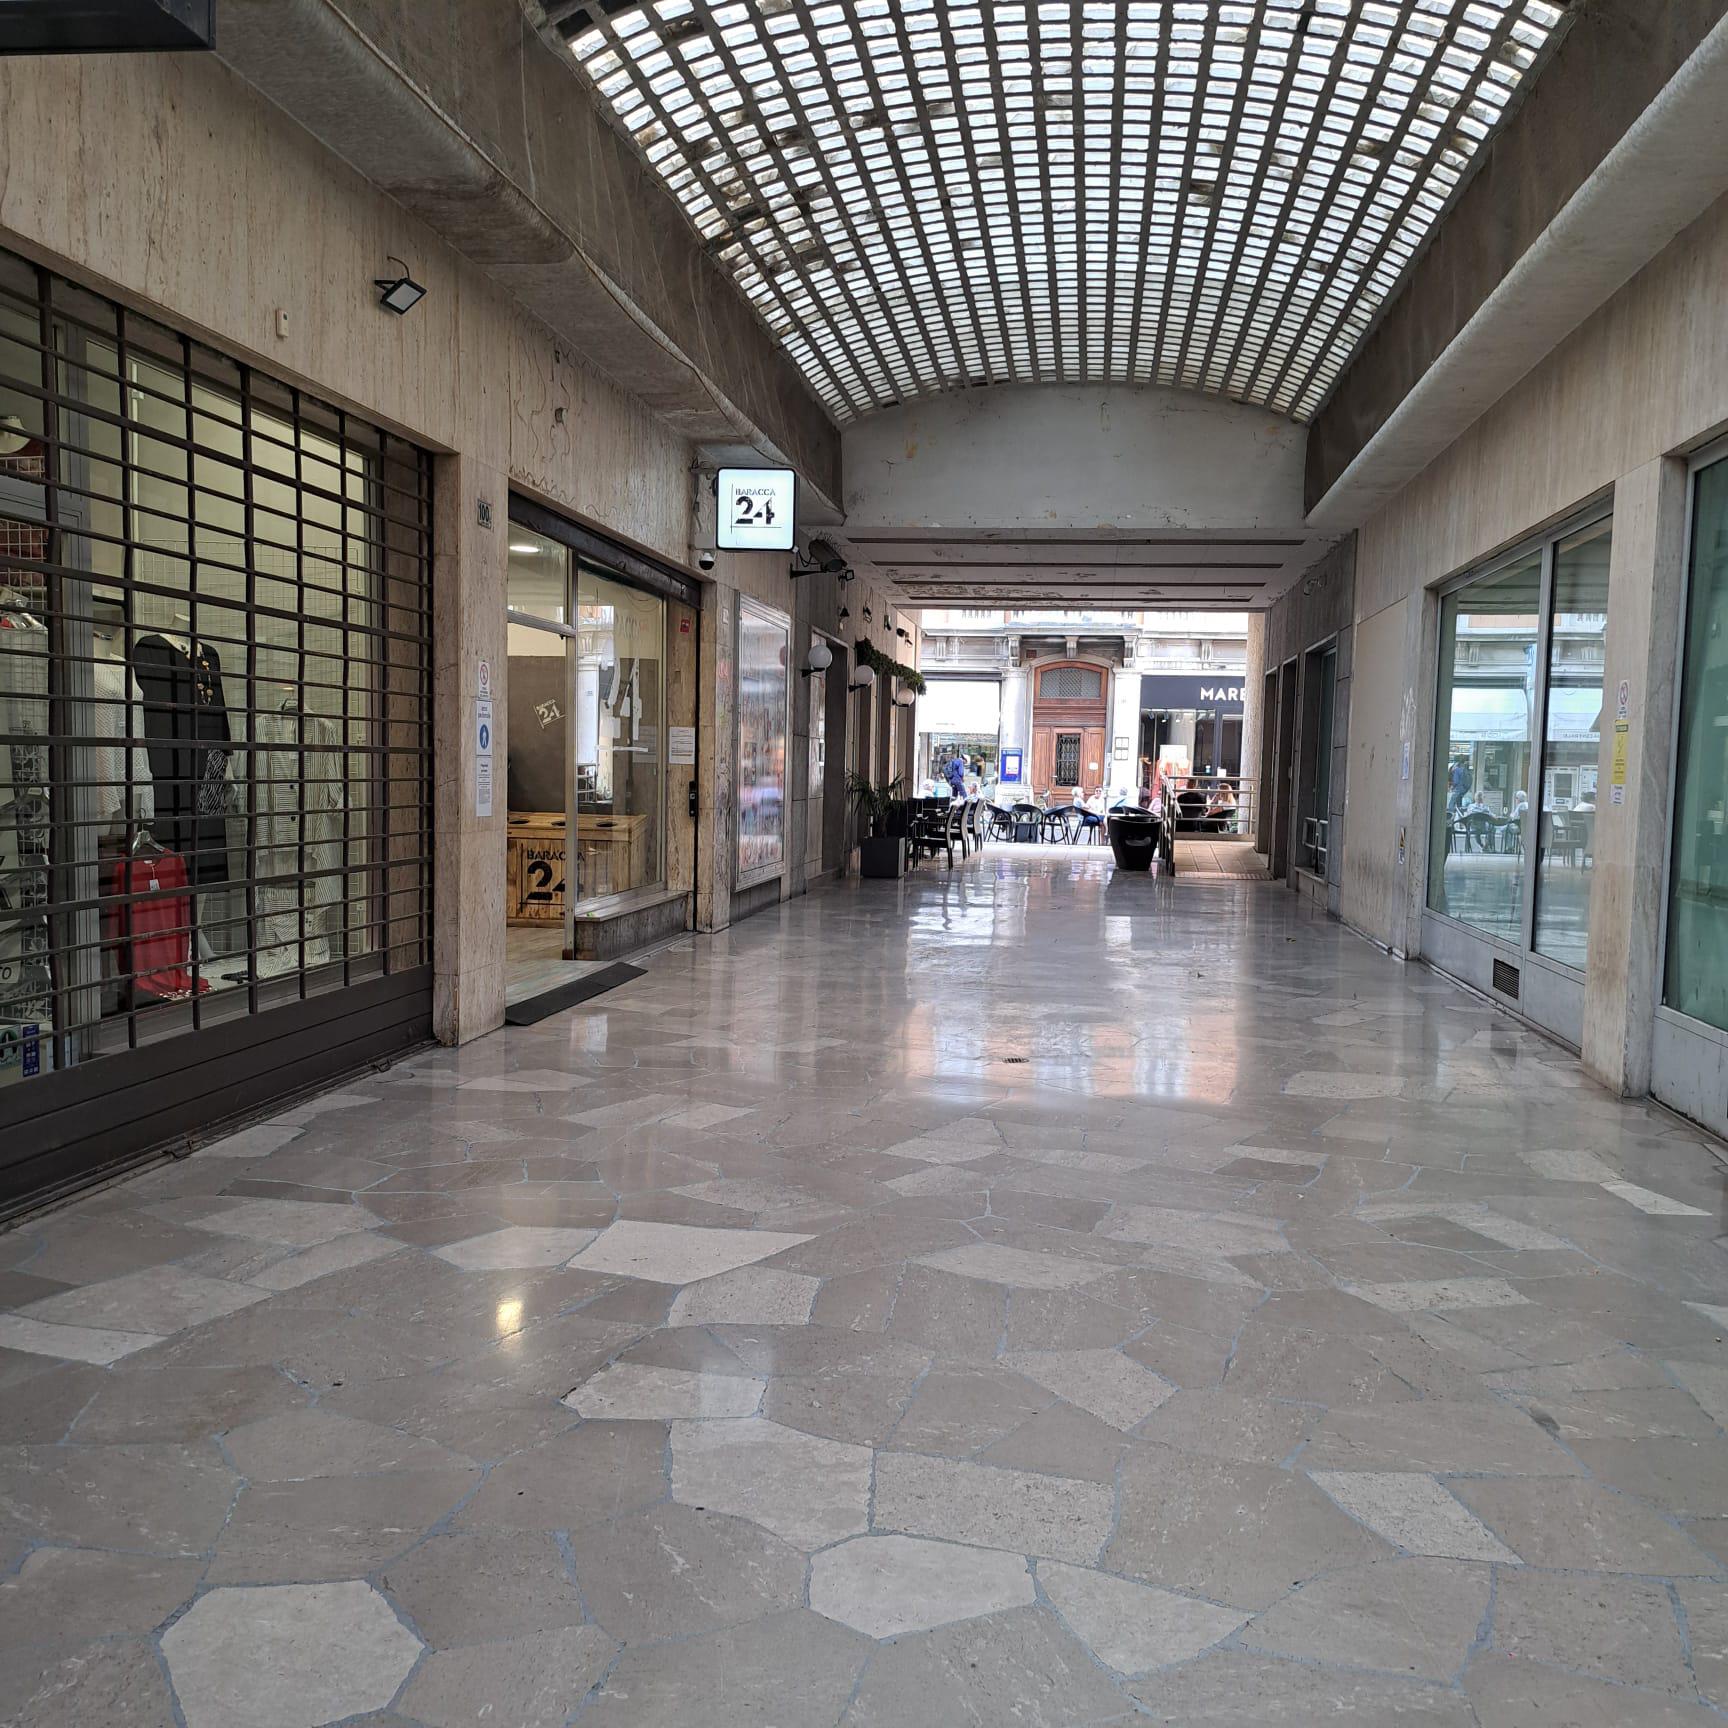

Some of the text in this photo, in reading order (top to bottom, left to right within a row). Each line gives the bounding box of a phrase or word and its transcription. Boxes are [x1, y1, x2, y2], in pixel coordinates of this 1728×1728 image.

[735, 488, 776, 496] BARACCA
[735, 496, 775, 525] 24
[527, 849, 585, 861] BARACA
